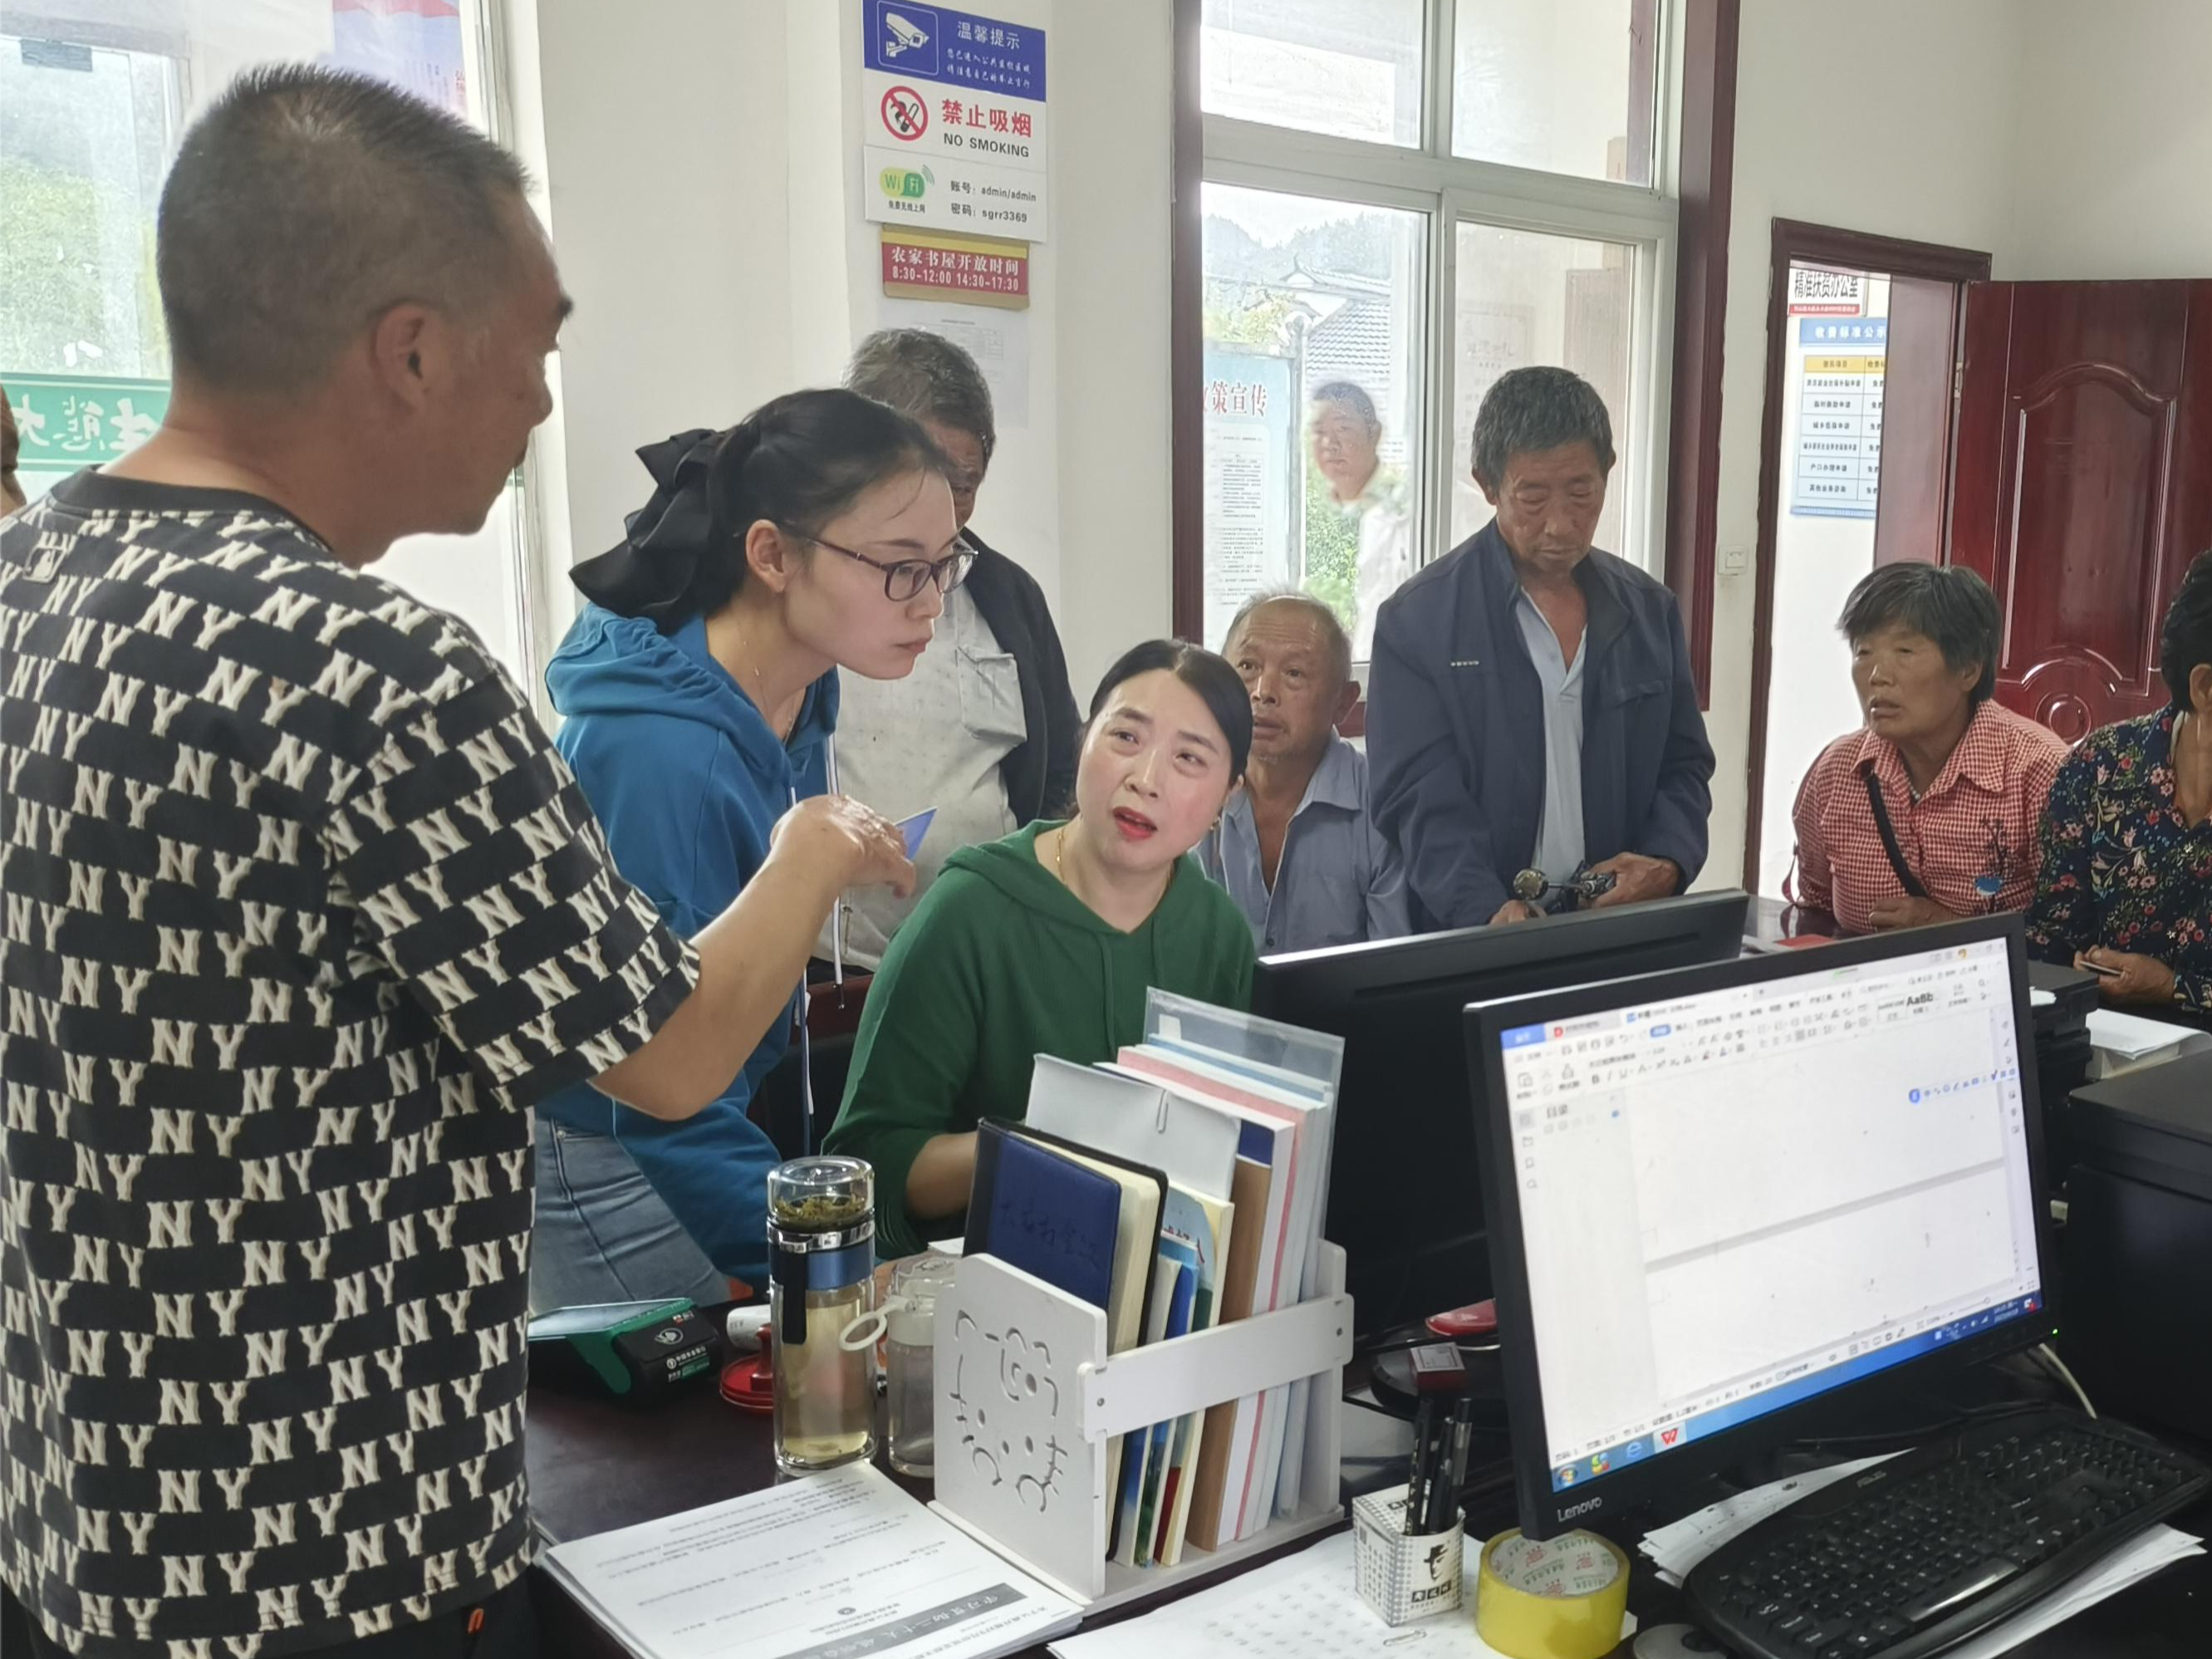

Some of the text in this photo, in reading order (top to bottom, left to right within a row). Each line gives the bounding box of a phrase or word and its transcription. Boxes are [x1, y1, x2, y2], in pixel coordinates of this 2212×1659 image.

[957, 21, 1020, 51] 温馨提示
[942, 99, 1032, 138] 禁止吸烟
[944, 133, 1029, 158] NO SMOKING
[888, 200, 925, 214] 免费无线上网
[981, 185, 1037, 202] admin/admin
[982, 209, 1028, 223] sgrr3369
[891, 246, 1019, 276] 农家书屋开放时间
[892, 266, 1018, 291] 8:30-12:00 14:30-17:30
[1794, 271, 1859, 299] 精准扶贫办公室
[1815, 325, 1886, 339] 收费标准公示
[1204, 380, 1268, 417] 策宣传
[105, 545, 199, 587] NY
[197, 540, 311, 582] NY
[41, 576, 103, 616] NY
[135, 589, 246, 651] NY
[250, 586, 369, 646] NY
[58, 616, 135, 670] NY
[7, 654, 57, 703] NY
[95, 672, 192, 737] NY
[196, 655, 310, 727] NY
[310, 648, 420, 728] NY
[31, 705, 95, 761] NY
[457, 713, 538, 785] NY
[72, 764, 164, 829] NY
[169, 743, 261, 809] NY
[261, 732, 361, 805] NY
[13, 798, 72, 856] NY
[407, 785, 503, 864] NY
[66, 859, 154, 920] NY
[156, 835, 253, 900] NY
[7, 891, 70, 953] NY
[359, 864, 453, 938] NY
[463, 862, 557, 939] NY
[156, 925, 250, 978] NY
[241, 901, 326, 958] NY
[60, 955, 154, 1014] NY
[417, 939, 511, 1012] NY
[519, 935, 611, 1009] NY
[8, 985, 62, 1048] NY
[248, 978, 333, 1028] NY
[150, 1018, 250, 1071] NY
[331, 1014, 390, 1069] NY
[475, 1009, 566, 1082] NY
[576, 1004, 653, 1073] NY
[63, 1050, 148, 1107] NY
[241, 1066, 332, 1115] NY
[7, 1085, 71, 1139] NY
[149, 1107, 245, 1157] NY
[313, 1098, 396, 1147] NY
[75, 1141, 146, 1201] NY
[240, 1148, 316, 1202] NY
[390, 1120, 444, 1179] NY
[449, 1148, 526, 1203] NY
[147, 1198, 245, 1249] NY
[317, 1178, 390, 1234] NY
[388, 1204, 459, 1262] NY
[71, 1234, 145, 1288] NY
[243, 1236, 331, 1287] NY
[462, 1230, 531, 1288] NY
[153, 1288, 246, 1339] NY
[334, 1261, 395, 1321] NY
[396, 1289, 473, 1346] NY
[67, 1329, 154, 1378] NY
[244, 1323, 336, 1378] NY
[475, 1315, 528, 1371] NY
[159, 1378, 250, 1426] NY
[329, 1346, 404, 1405] NY
[406, 1372, 484, 1431] NY
[71, 1417, 155, 1469] NY
[248, 1406, 337, 1466] NY
[341, 1431, 414, 1490] NY
[158, 1467, 253, 1513] NY
[417, 1455, 488, 1515] NY
[1557, 1496, 1603, 1522] Lenovo
[76, 1504, 159, 1555] NY
[251, 1492, 346, 1549] NY
[344, 1513, 423, 1573] NY
[161, 1550, 257, 1598] NY
[424, 1533, 497, 1594] NY
[79, 1591, 161, 1640] NY
[255, 1574, 350, 1632] NY
